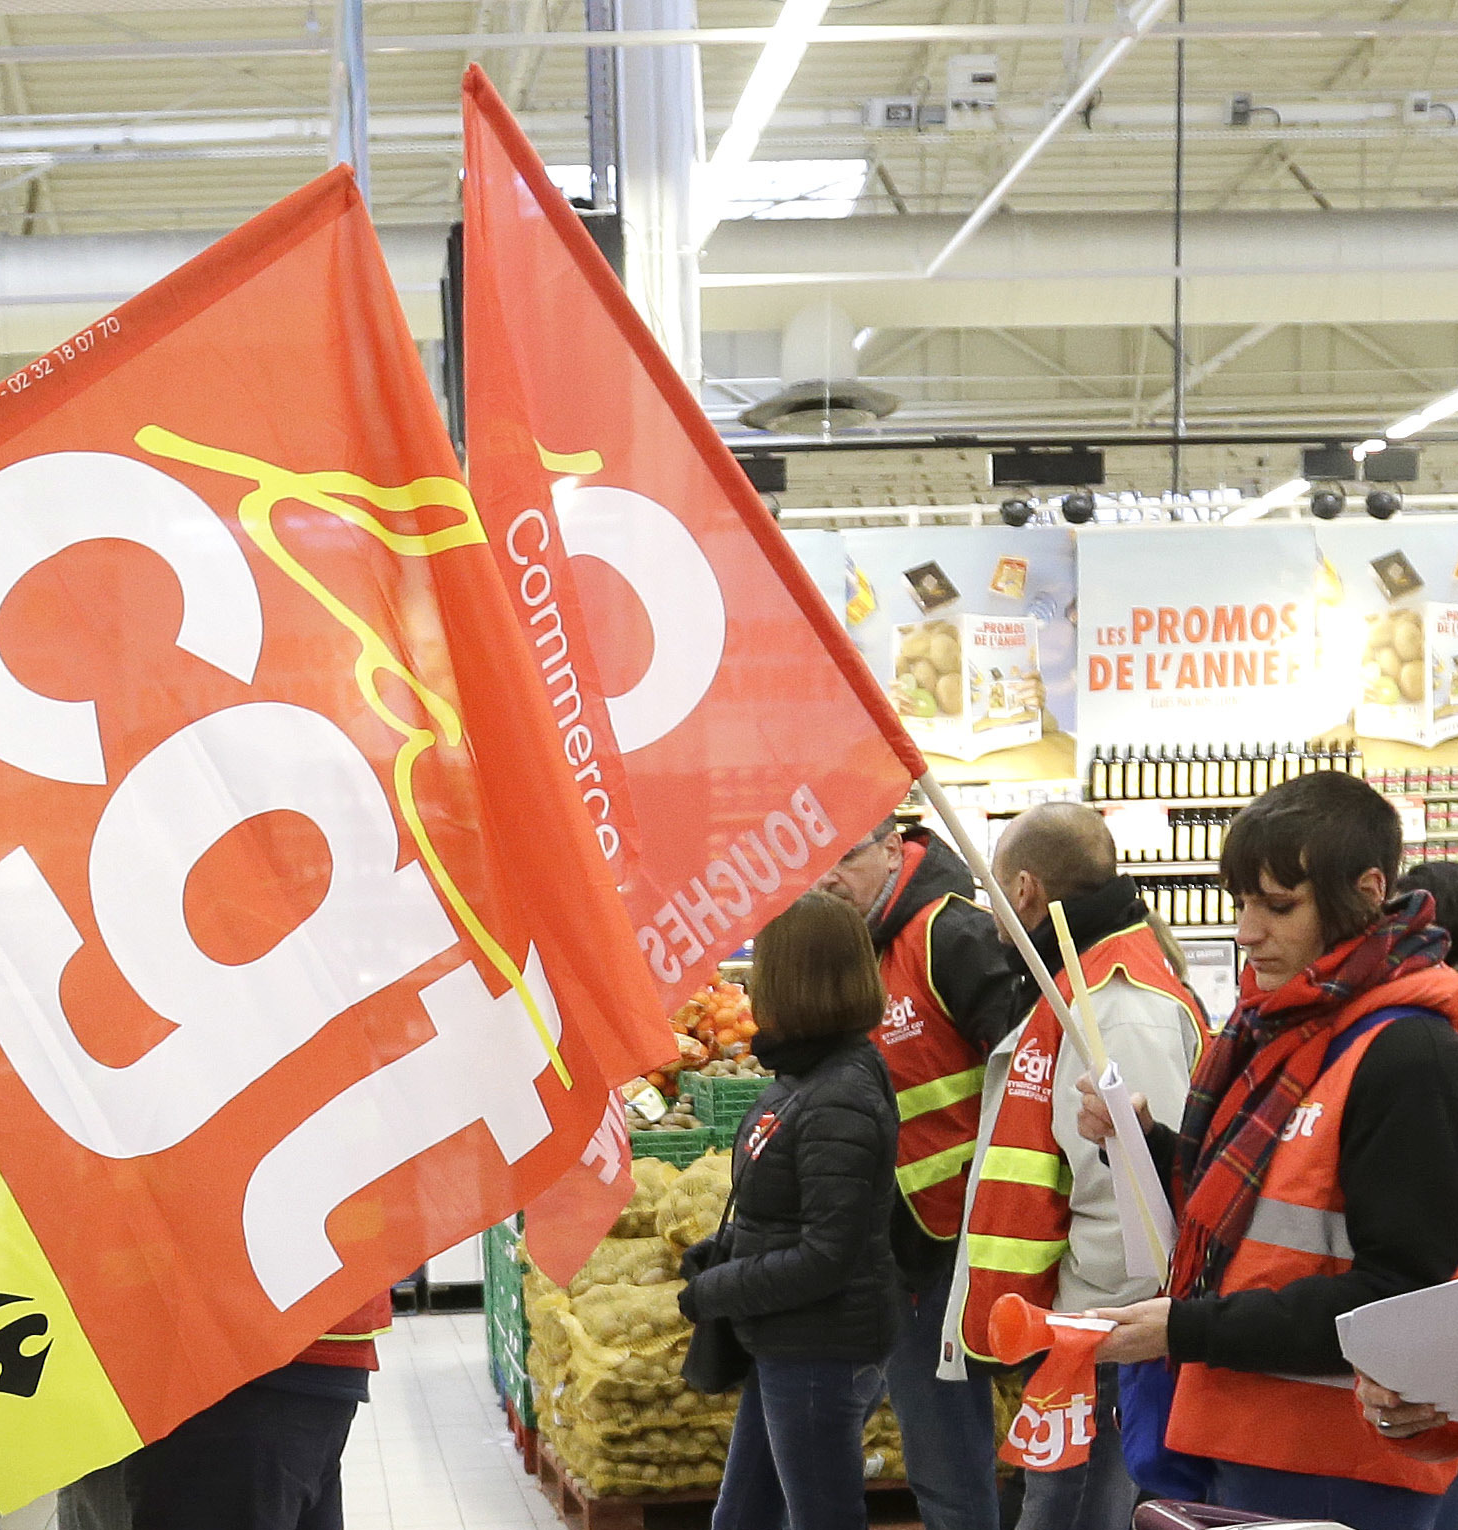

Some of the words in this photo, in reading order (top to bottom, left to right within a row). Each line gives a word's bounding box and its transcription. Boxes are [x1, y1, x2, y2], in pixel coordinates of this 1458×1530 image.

[7, 371, 30, 395] 02
[30, 357, 54, 380] 32
[54, 344, 76, 365] 18
[75, 330, 97, 352] 07
[96, 315, 121, 338] 70
[1097, 626, 1127, 646] LES
[1131, 601, 1298, 645] PROMOS
[1088, 653, 1135, 691] DE
[881, 996, 917, 1028] cgt
[1013, 1052, 1053, 1084] cgt
[1280, 1101, 1325, 1142] gt
[1008, 1393, 1093, 1467] cgt
